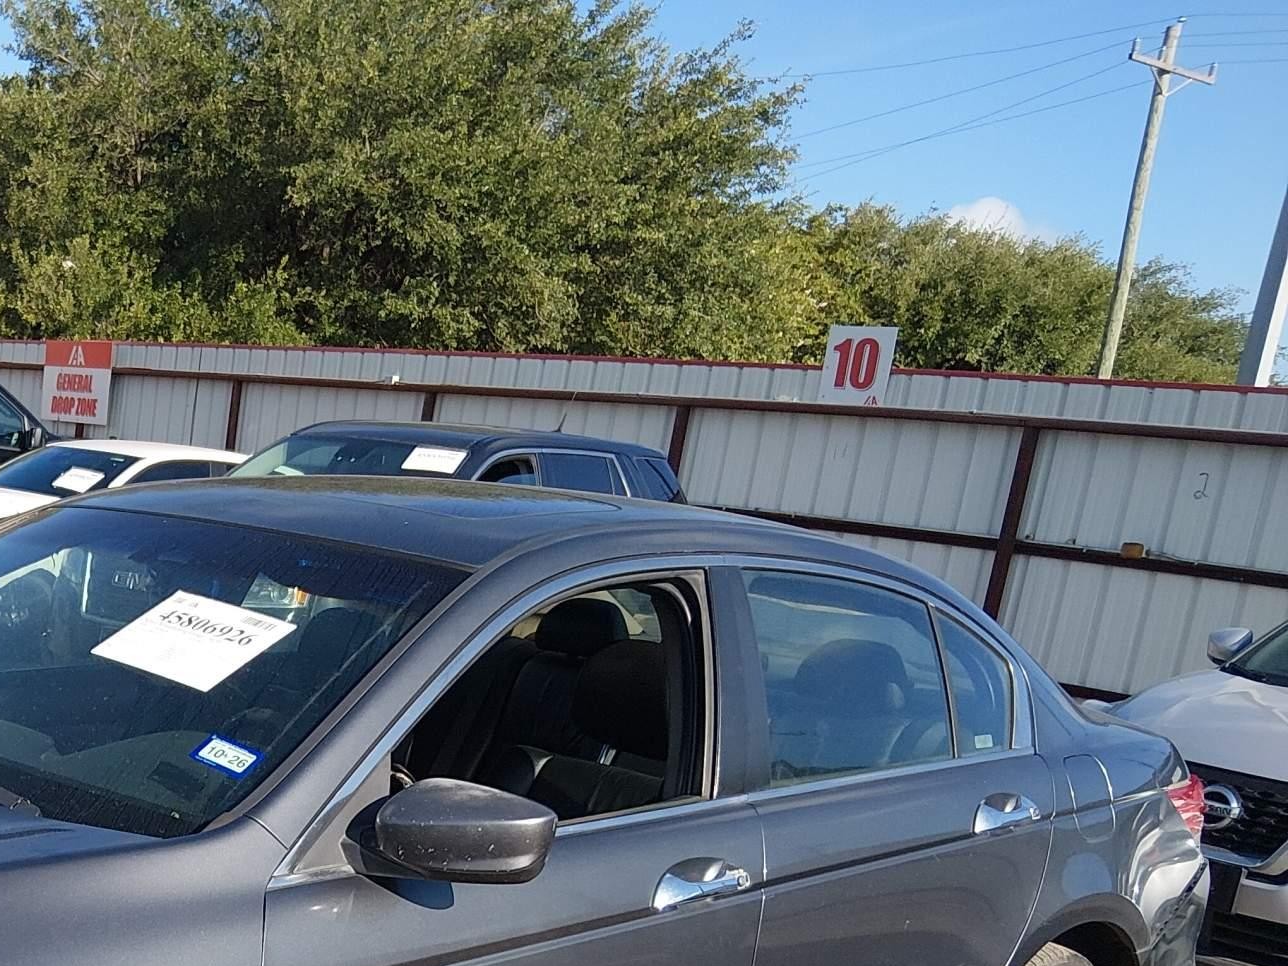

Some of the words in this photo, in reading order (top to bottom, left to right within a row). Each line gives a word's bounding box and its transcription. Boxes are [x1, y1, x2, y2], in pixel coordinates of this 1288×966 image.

[833, 337, 880, 391] 10
[56, 372, 93, 393] GENERAL
[50, 395, 76, 415] DROP
[75, 397, 98, 417] ZONE
[1192, 472, 1209, 500] 2
[160, 610, 258, 646] 45806926
[207, 746, 225, 759] 10
[227, 755, 249, 769] 26
